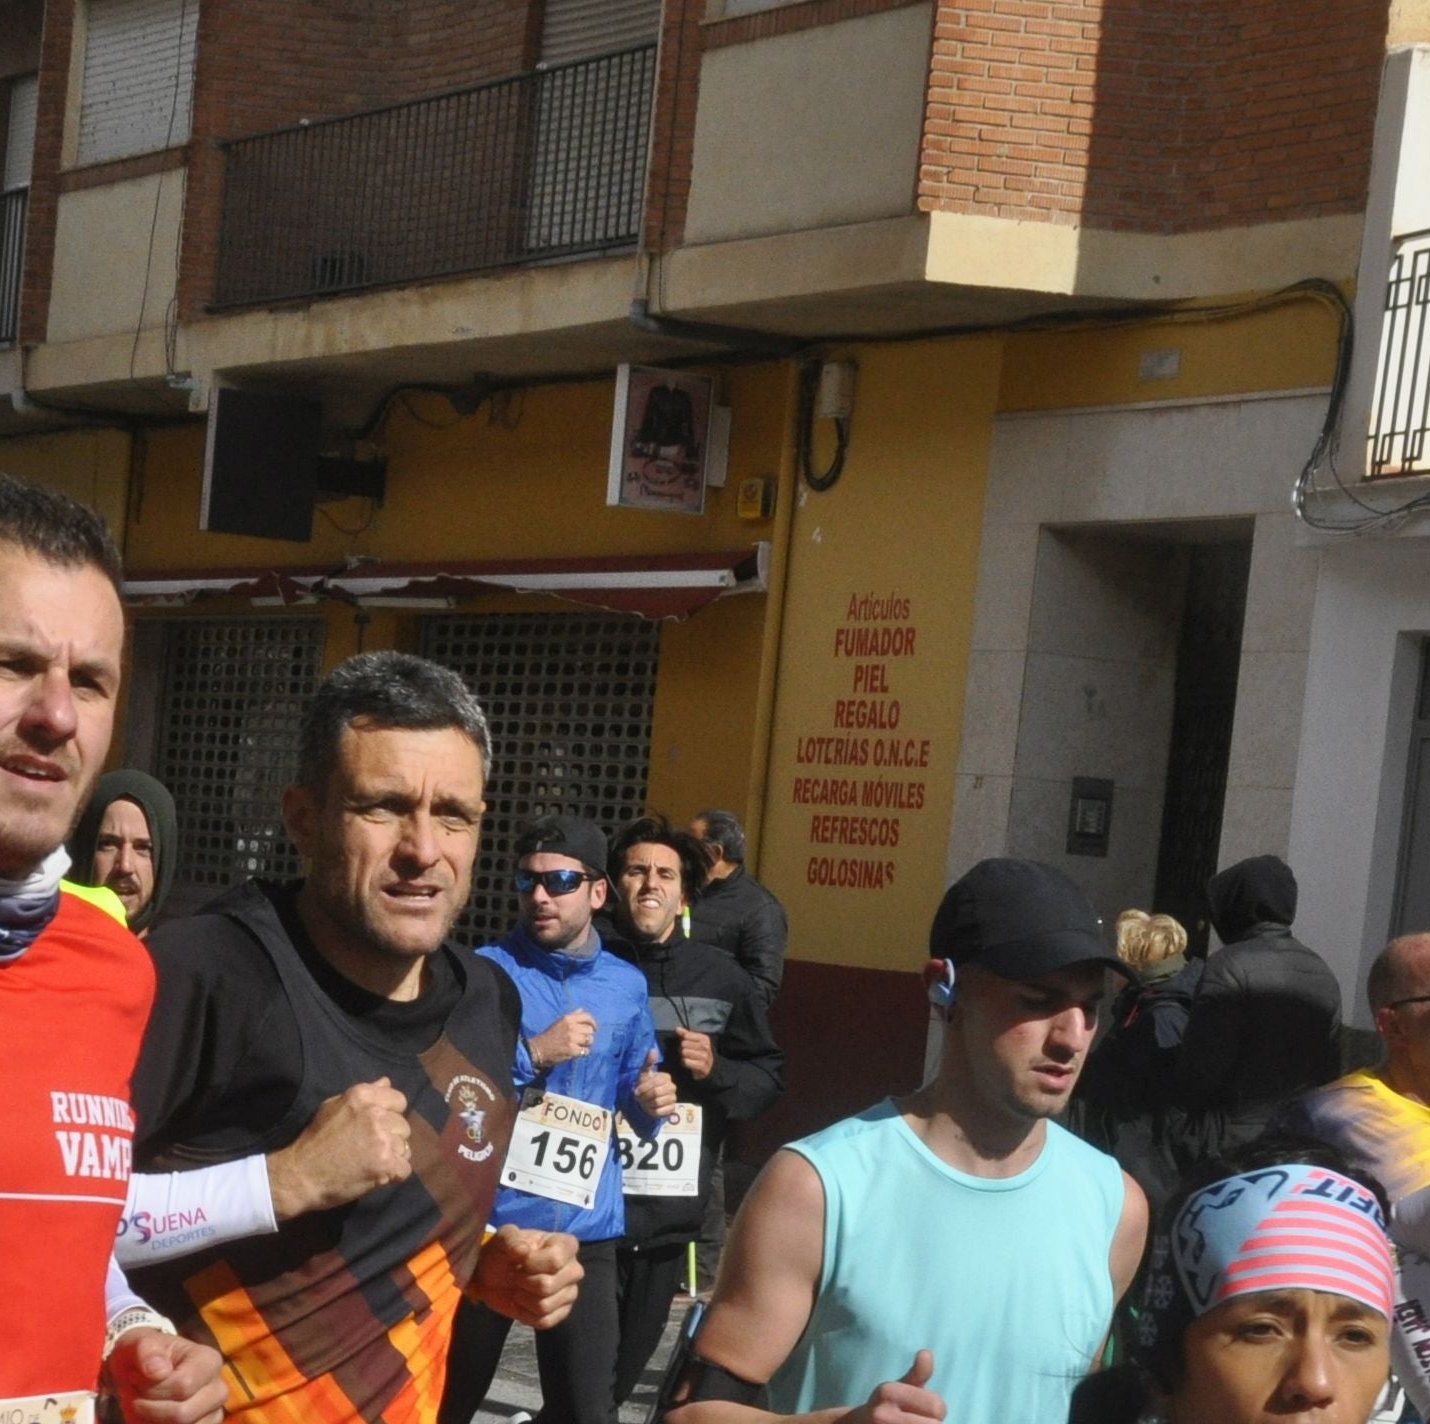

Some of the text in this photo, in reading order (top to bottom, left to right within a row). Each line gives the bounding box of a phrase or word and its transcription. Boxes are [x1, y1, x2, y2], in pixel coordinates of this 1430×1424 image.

[834, 627, 917, 657] FUMADOR
[853, 664, 889, 694] PIEL
[834, 700, 901, 730] REGALO
[796, 731, 870, 766] LOTERÍAS
[793, 774, 926, 809] RECARGA MÓVILES
[810, 815, 900, 847] REFRESCOS
[544, 1101, 602, 1131] FONDO
[530, 1130, 598, 1180] 156
[151, 1224, 217, 1251] DEPORTES
